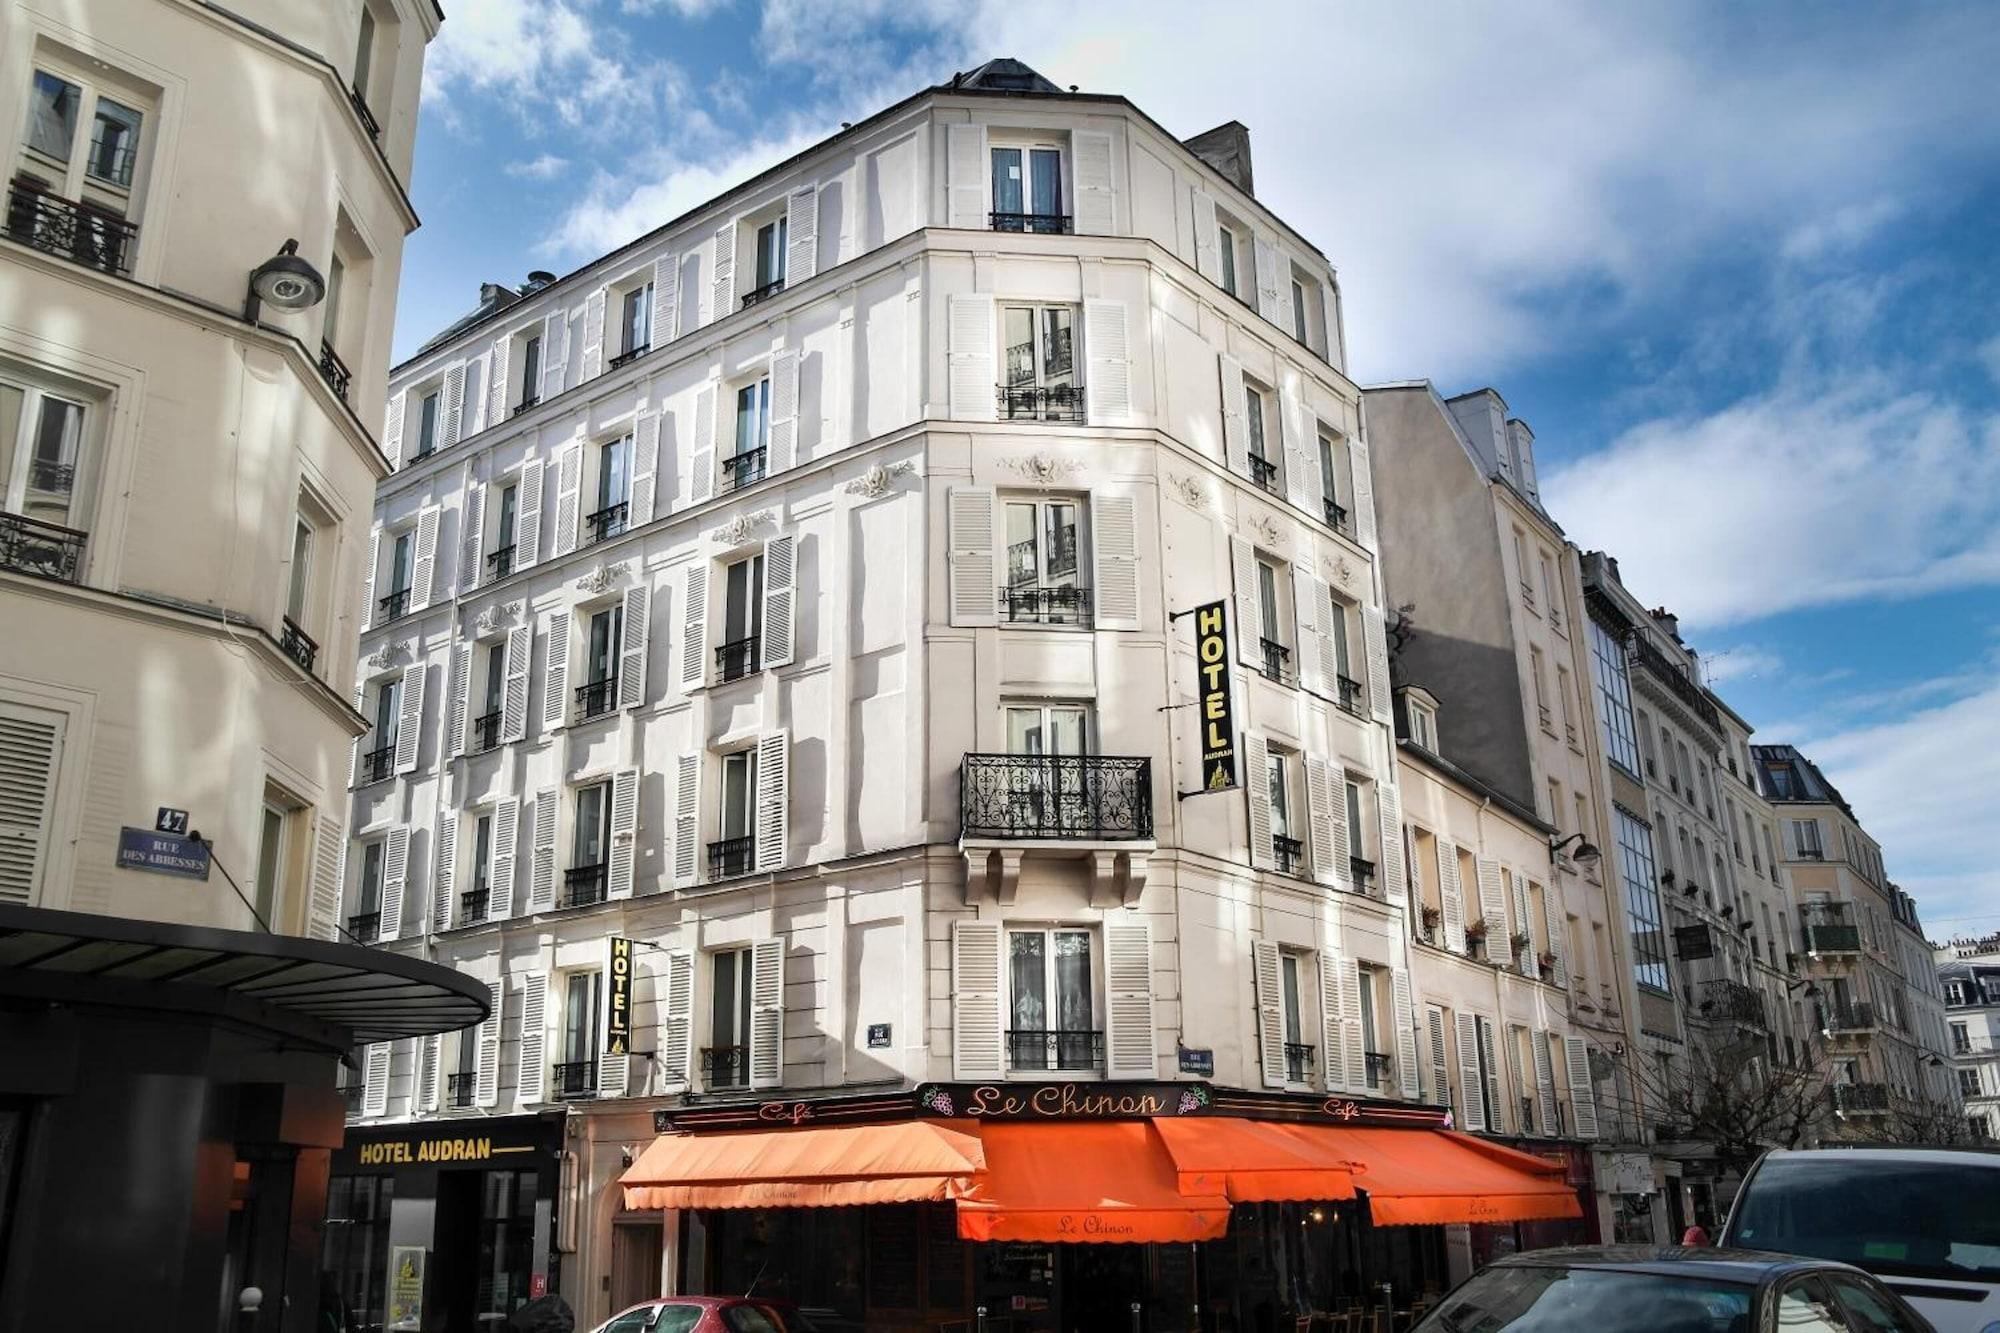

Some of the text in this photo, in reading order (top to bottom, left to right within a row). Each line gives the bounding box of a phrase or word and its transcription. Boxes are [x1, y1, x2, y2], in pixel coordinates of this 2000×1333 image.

[1200, 607, 1228, 748] HOTEL
[1204, 749, 1232, 760] AUDRAN
[161, 810, 185, 831] 47
[153, 840, 180, 854] RUE
[122, 850, 205, 871] DES ABBESSES
[614, 939, 629, 1028] HOTEL
[967, 1084, 1166, 1115] Le Chinon
[1324, 1099, 1360, 1120] Café
[760, 1104, 815, 1124] Café
[360, 1138, 490, 1164] HOTEL AUDRAN
[1057, 1215, 1134, 1234] Le Chinon
